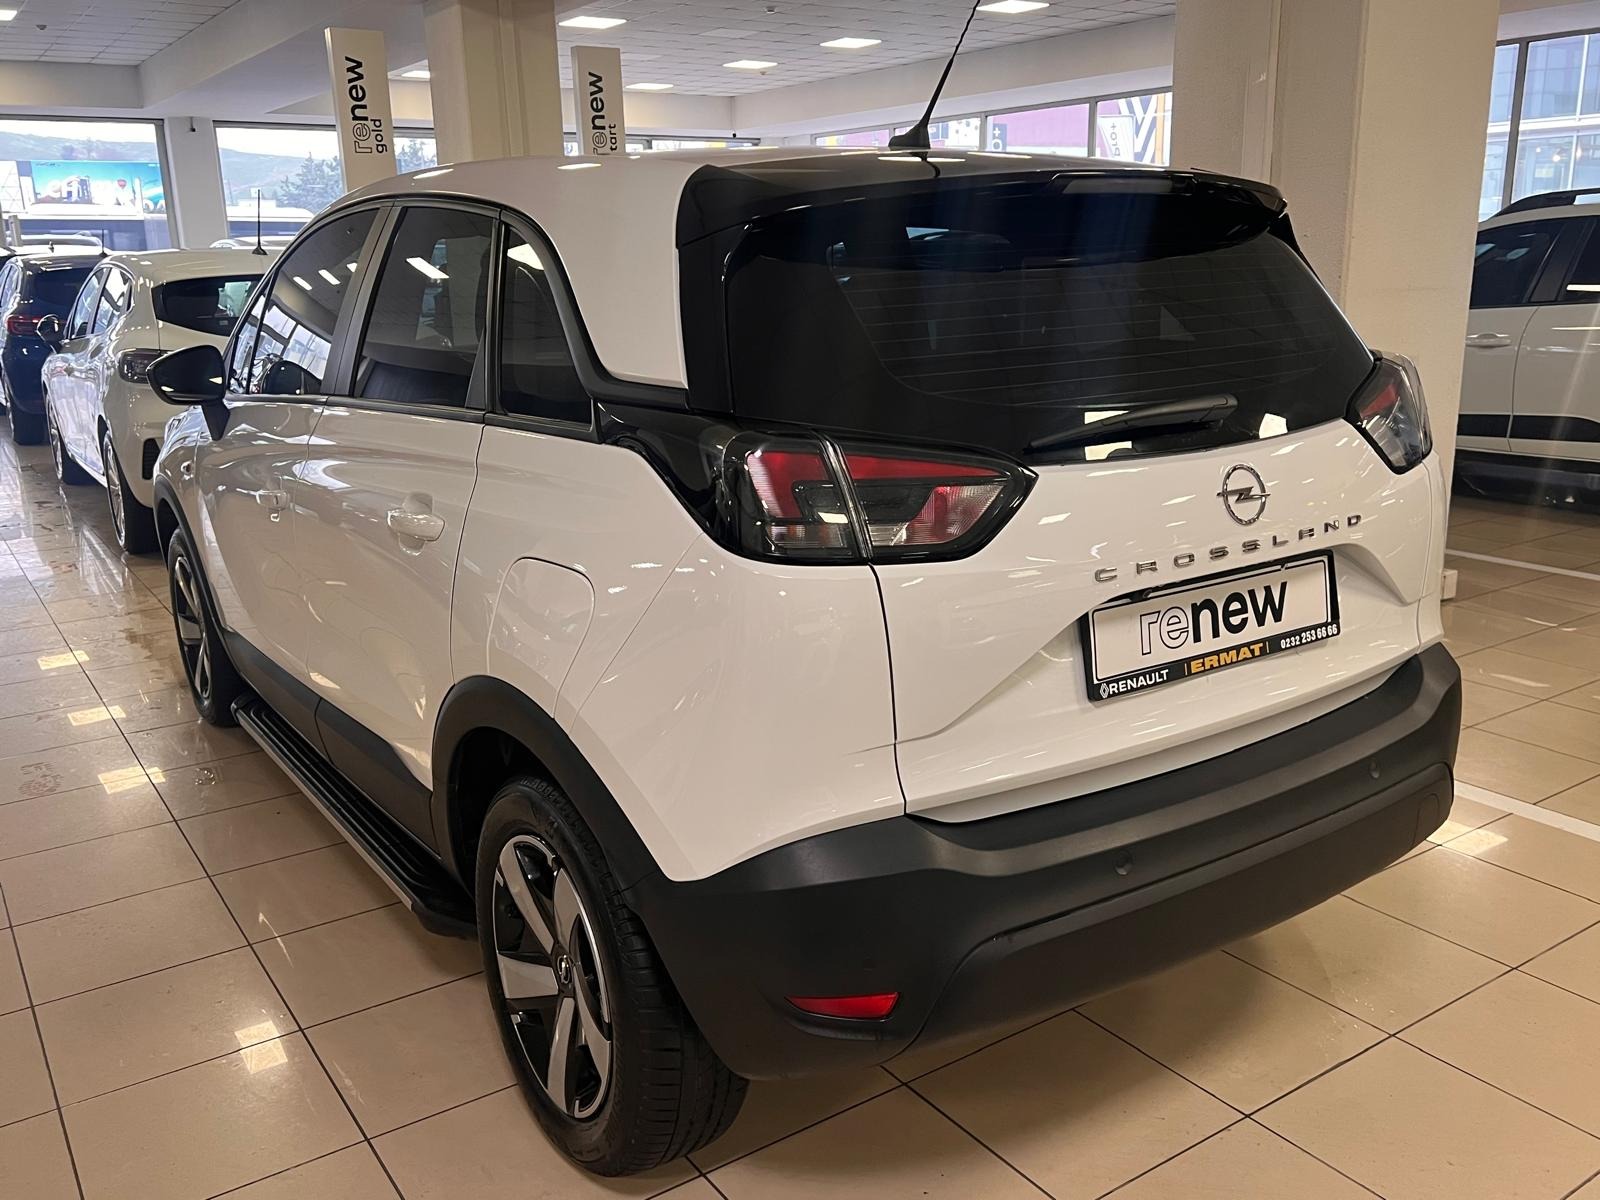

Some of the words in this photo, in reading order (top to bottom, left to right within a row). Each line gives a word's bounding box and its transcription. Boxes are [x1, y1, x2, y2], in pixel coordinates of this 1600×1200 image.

[344, 55, 373, 154] renew
[370, 118, 388, 154] gold
[1094, 514, 1362, 583] CROSSLAND
[1139, 581, 1288, 656] renew
[1109, 669, 1169, 695] RENAULT
[1190, 643, 1264, 674] ERMAT
[1280, 635, 1301, 649] 0232
[1301, 629, 1316, 644] 253
[1316, 627, 1327, 639] 66
[1327, 623, 1338, 636] 66
